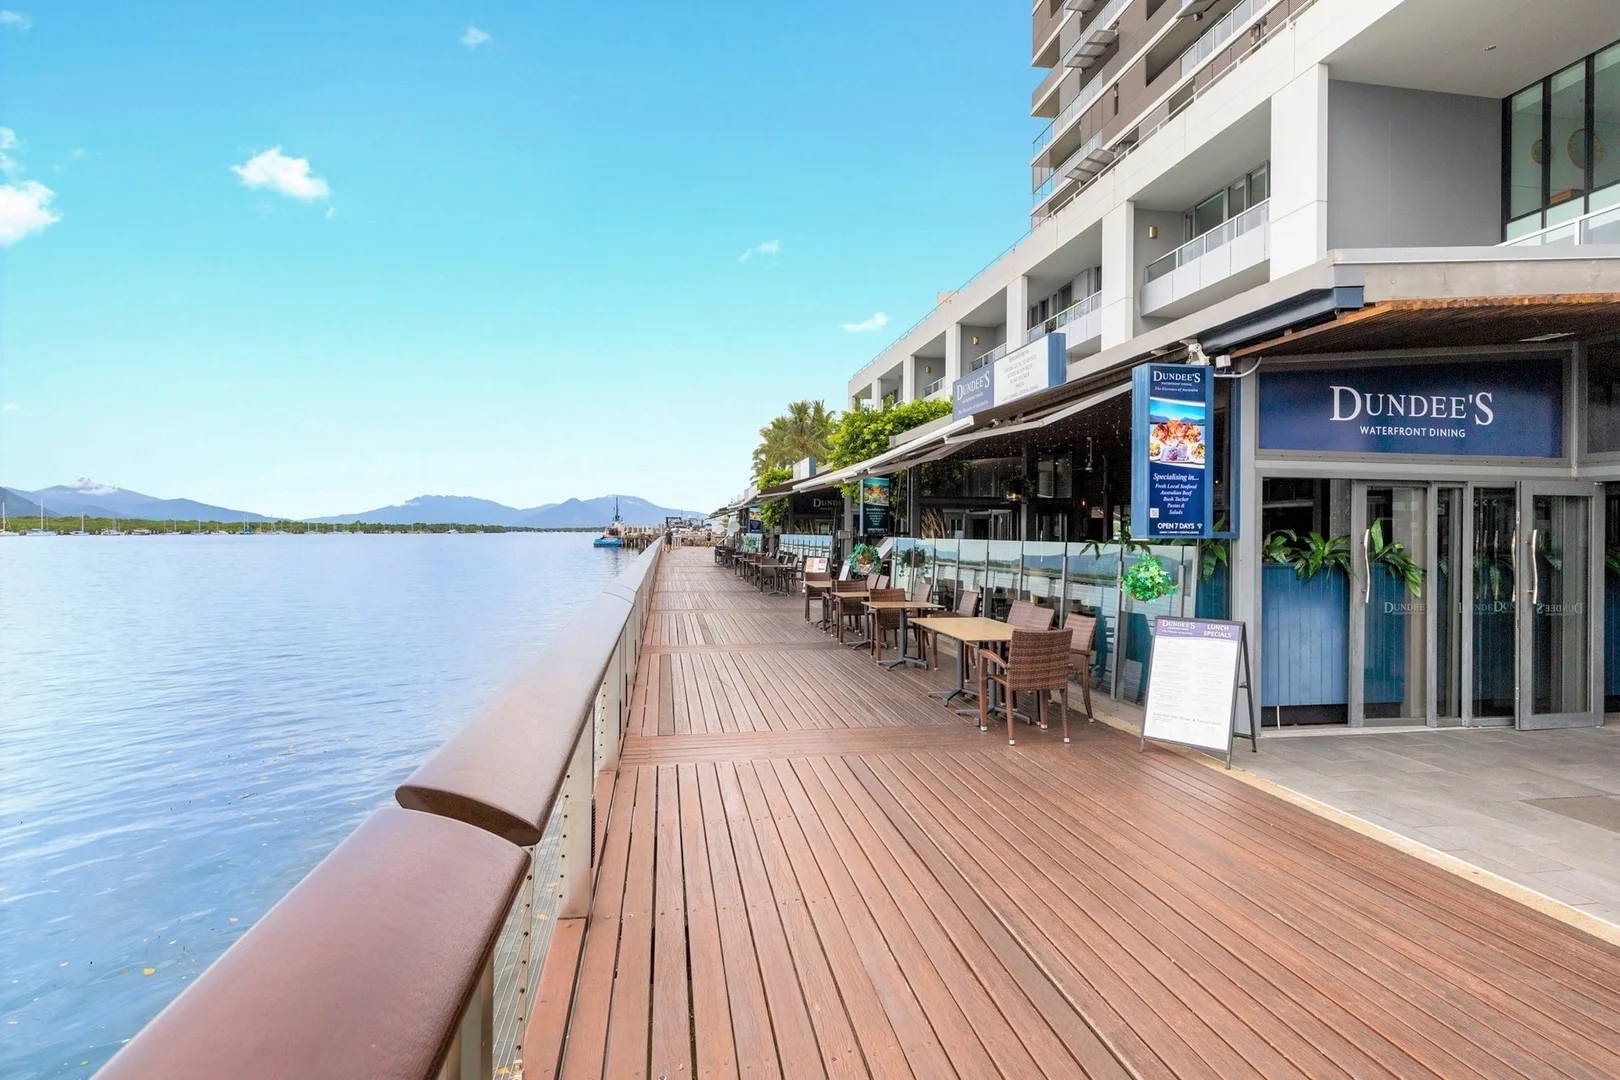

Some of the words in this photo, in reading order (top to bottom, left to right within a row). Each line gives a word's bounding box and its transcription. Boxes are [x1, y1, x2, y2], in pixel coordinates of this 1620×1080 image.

[1153, 370, 1201, 383] DUNDEE'S
[956, 370, 990, 401] DUNDEE'S
[1329, 385, 1494, 426] DUNDEE'S
[1359, 425, 1427, 436] WATERFRONT
[1429, 428, 1466, 438] DINING
[1153, 472, 1187, 482] Specialising
[1157, 522, 1174, 530] OPEN
[1174, 522, 1179, 530] 7
[1179, 522, 1195, 530] DAYS
[1162, 620, 1196, 630] DUNDEE'S
[1207, 623, 1229, 631] LUNCH
[1203, 630, 1232, 638] SPECIALS
